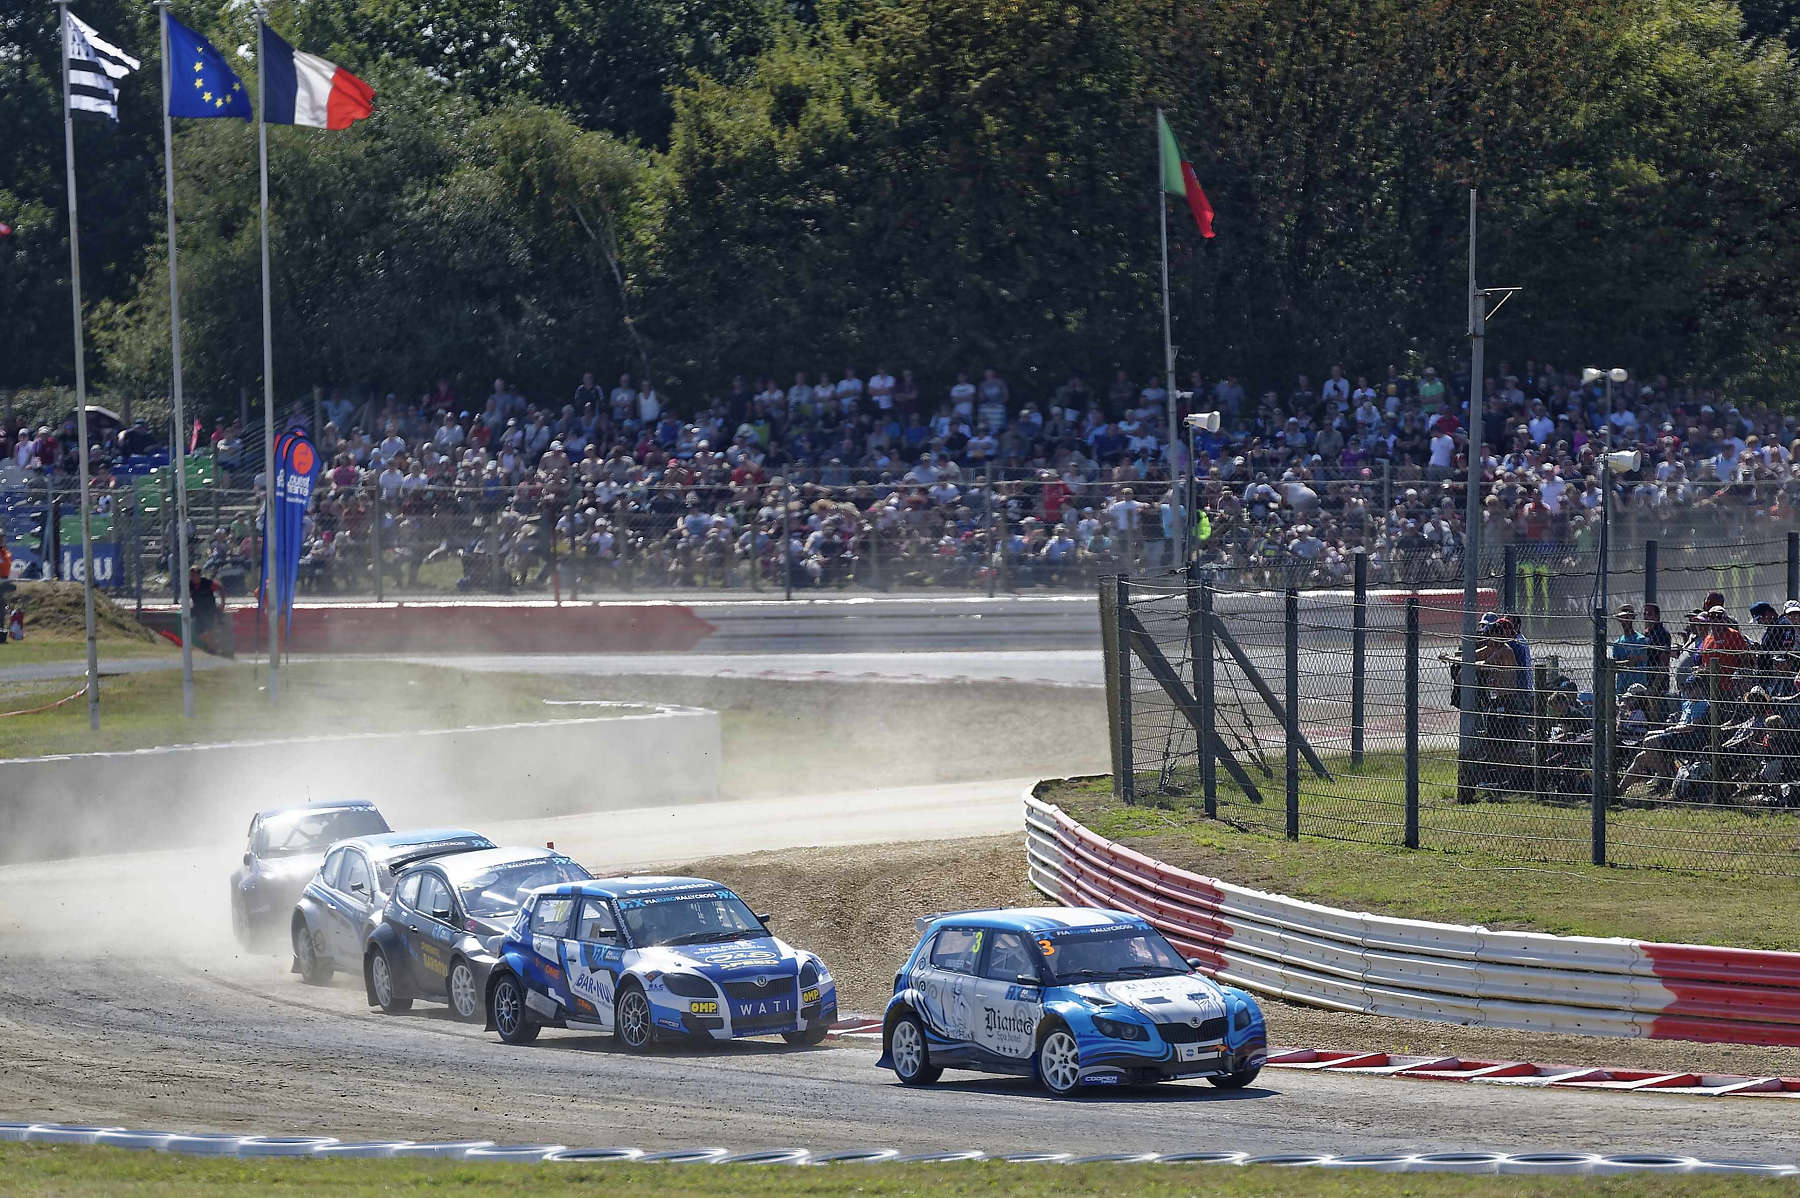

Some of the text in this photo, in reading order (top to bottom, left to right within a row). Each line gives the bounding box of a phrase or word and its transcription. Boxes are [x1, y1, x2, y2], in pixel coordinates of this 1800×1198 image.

[972, 931, 983, 953] 3
[1038, 939, 1055, 956] 3
[802, 989, 819, 1002] OMP
[690, 1002, 717, 1013] OMP
[740, 999, 790, 1016] WATI
